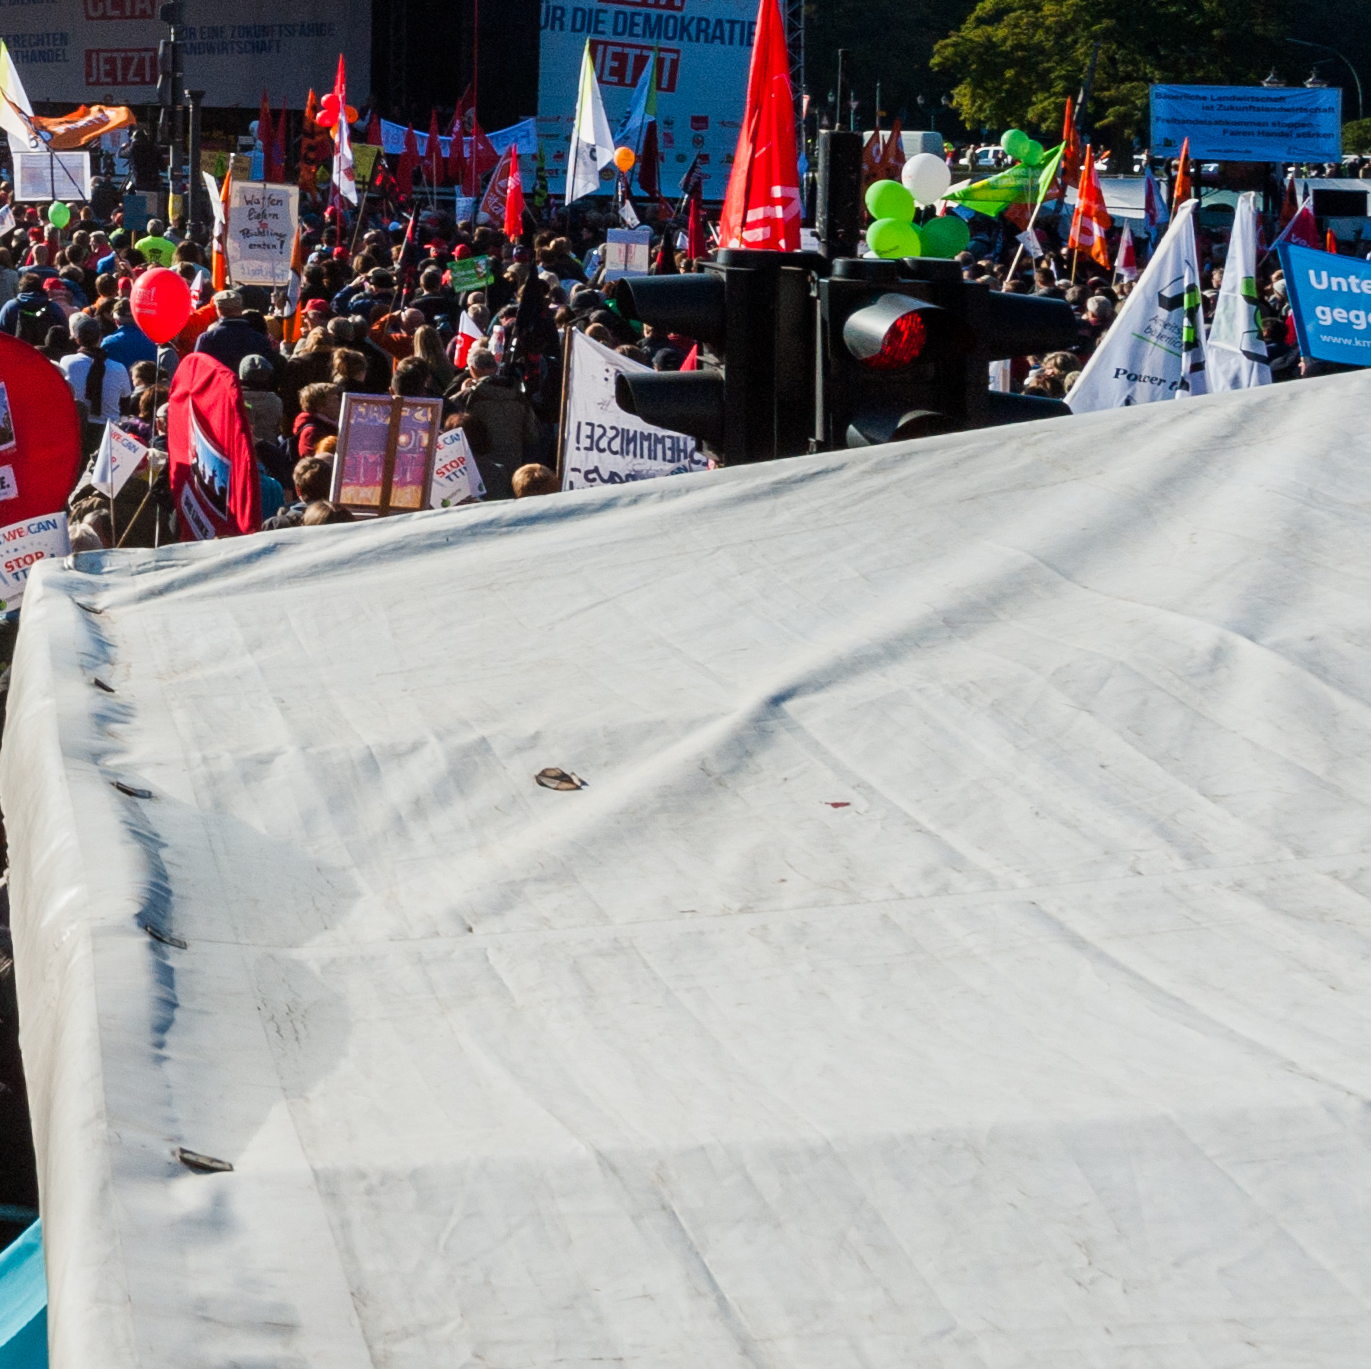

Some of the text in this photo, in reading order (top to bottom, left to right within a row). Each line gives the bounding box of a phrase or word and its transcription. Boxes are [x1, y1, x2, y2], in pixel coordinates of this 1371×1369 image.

[540, 0, 757, 48] ÜR DIE DEMOKRATIE
[3, 31, 69, 48] ERECHTEN
[183, 39, 281, 55] ANDWIRTSCHAFT
[88, 52, 156, 83] JETZT
[1202, 104, 1336, 114] ist Zukunftslandwirtschaft
[1210, 94, 1287, 103] Landwirtschaft
[1155, 116, 1314, 129] Freihandelsabkommen stoppen
[1222, 129, 1335, 139] Fairen Handel stärken
[243, 193, 284, 209] Waffen
[1308, 269, 1371, 294] Unte
[1315, 305, 1371, 330] geg
[1113, 367, 1167, 388] Power
[435, 456, 466, 478] STOP
[3, 526, 26, 542] WE
[27, 519, 58, 536] CAN
[5, 551, 45, 573] STOP
